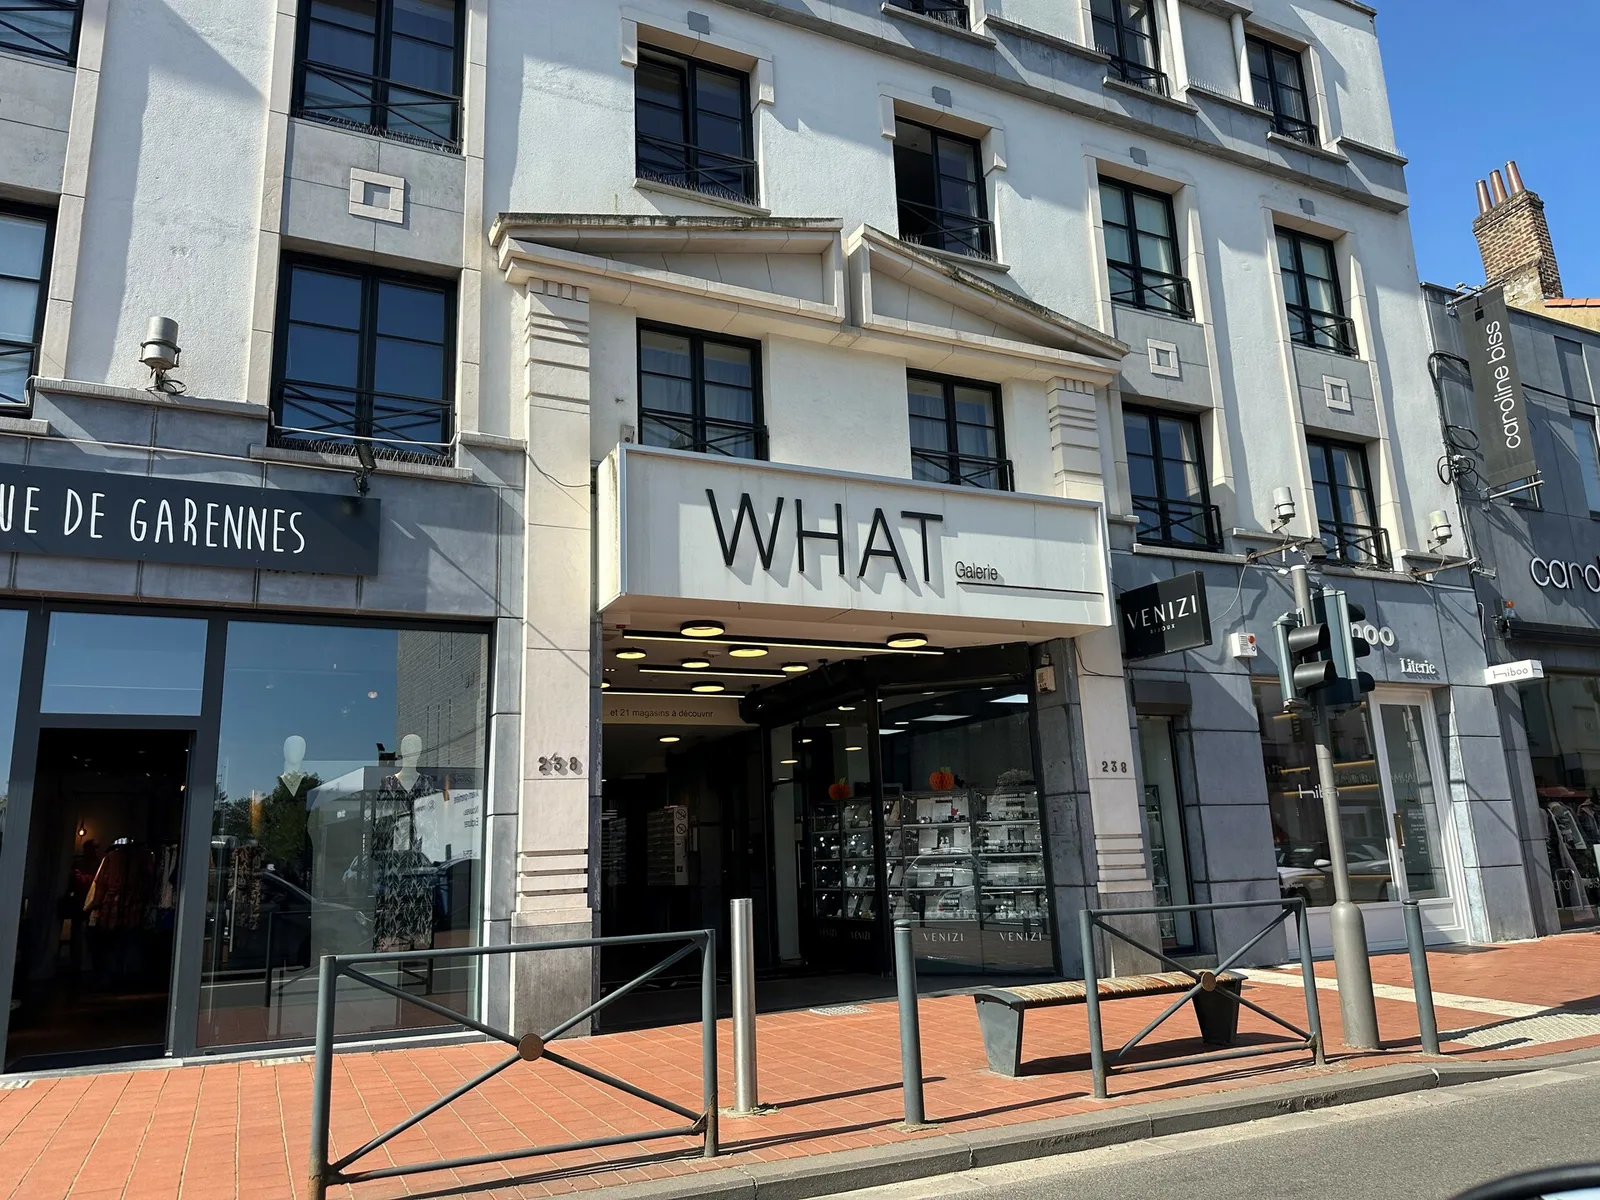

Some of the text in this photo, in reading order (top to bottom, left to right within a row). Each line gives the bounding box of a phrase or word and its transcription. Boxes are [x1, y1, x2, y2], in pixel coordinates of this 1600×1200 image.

[1486, 320, 1521, 449] caroline biss
[64, 488, 105, 538] DE
[130, 498, 306, 554] GARENNES
[705, 488, 943, 582] WHAT
[955, 560, 998, 581] Galerie
[1127, 594, 1197, 630] VENIZI
[1399, 657, 1437, 675] Literie
[620, 708, 630, 717] 21
[632, 709, 670, 719] magasins
[671, 708, 677, 717] à
[538, 755, 581, 774] 238
[1101, 760, 1127, 774] 238
[923, 932, 964, 942] VENIZI
[999, 932, 1042, 942] VENIZI
